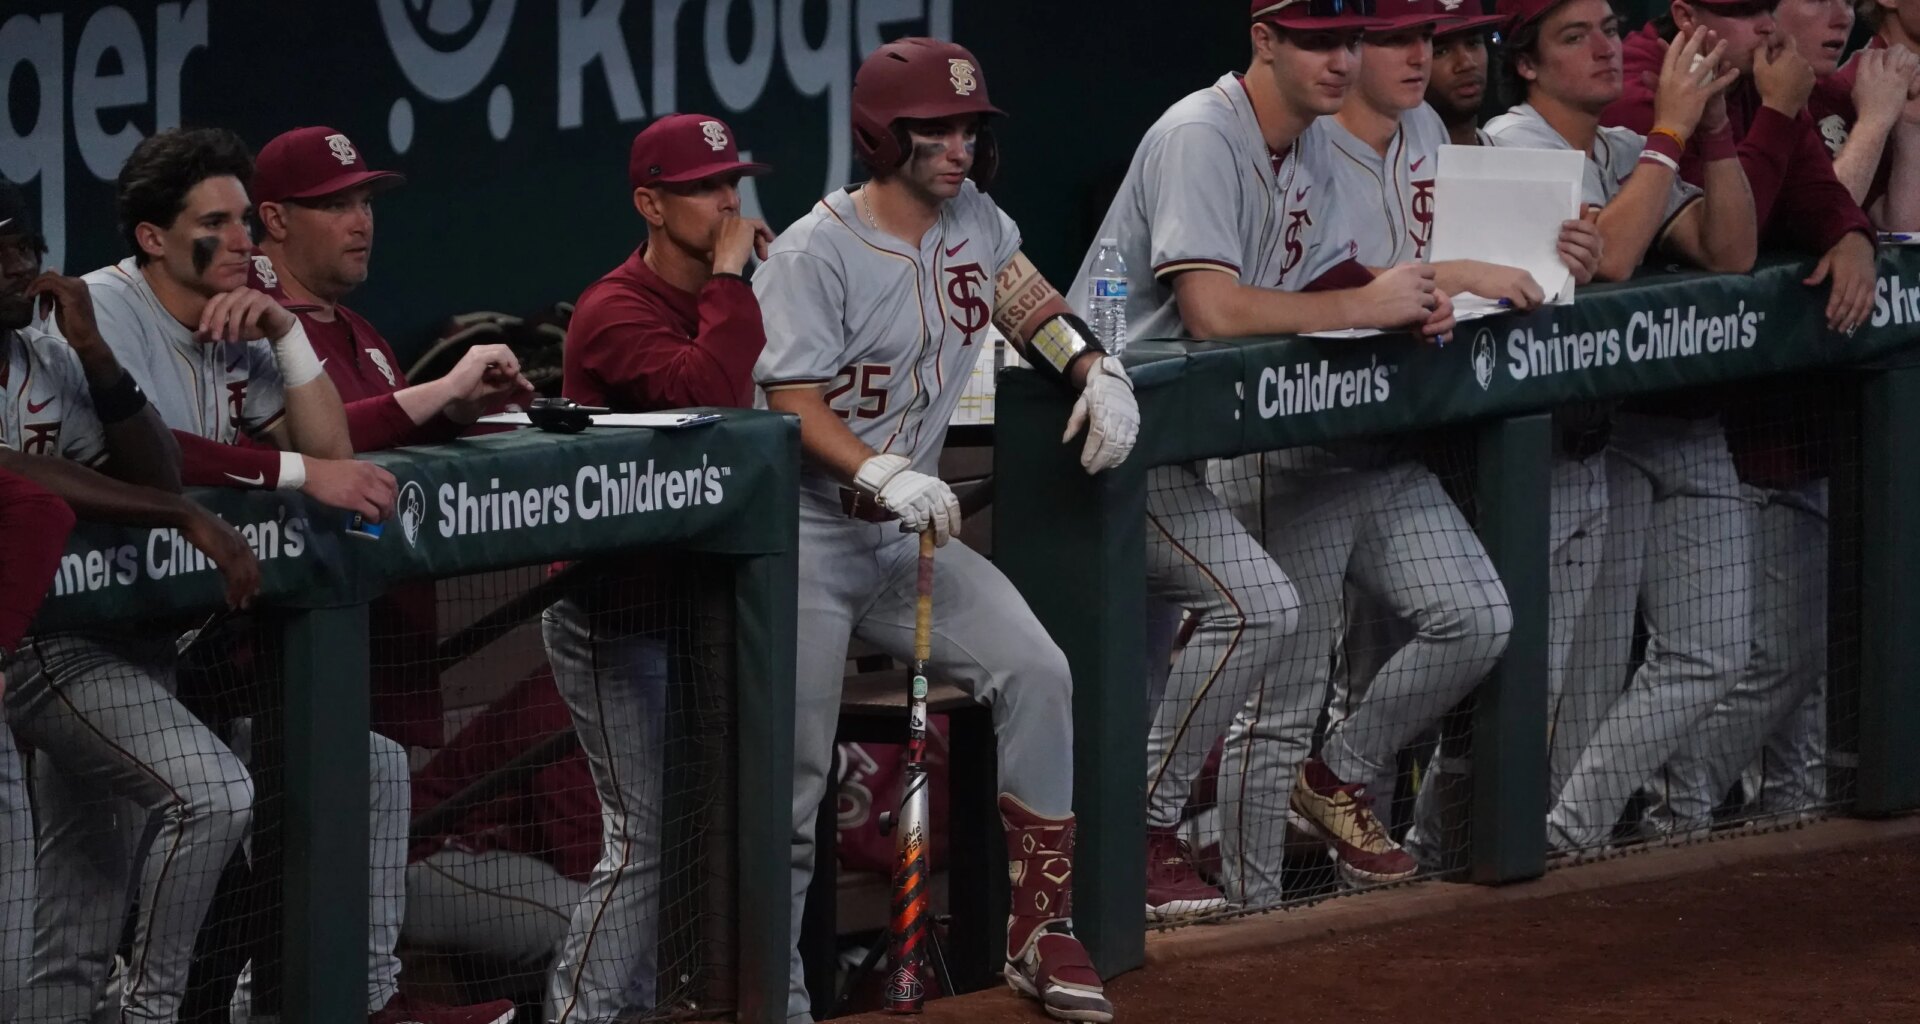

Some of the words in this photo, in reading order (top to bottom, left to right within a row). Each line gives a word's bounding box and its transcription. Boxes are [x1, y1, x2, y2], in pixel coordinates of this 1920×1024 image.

[1507, 322, 1621, 380] Shriners
[823, 364, 893, 419] 25
[438, 477, 570, 538] Shriners
